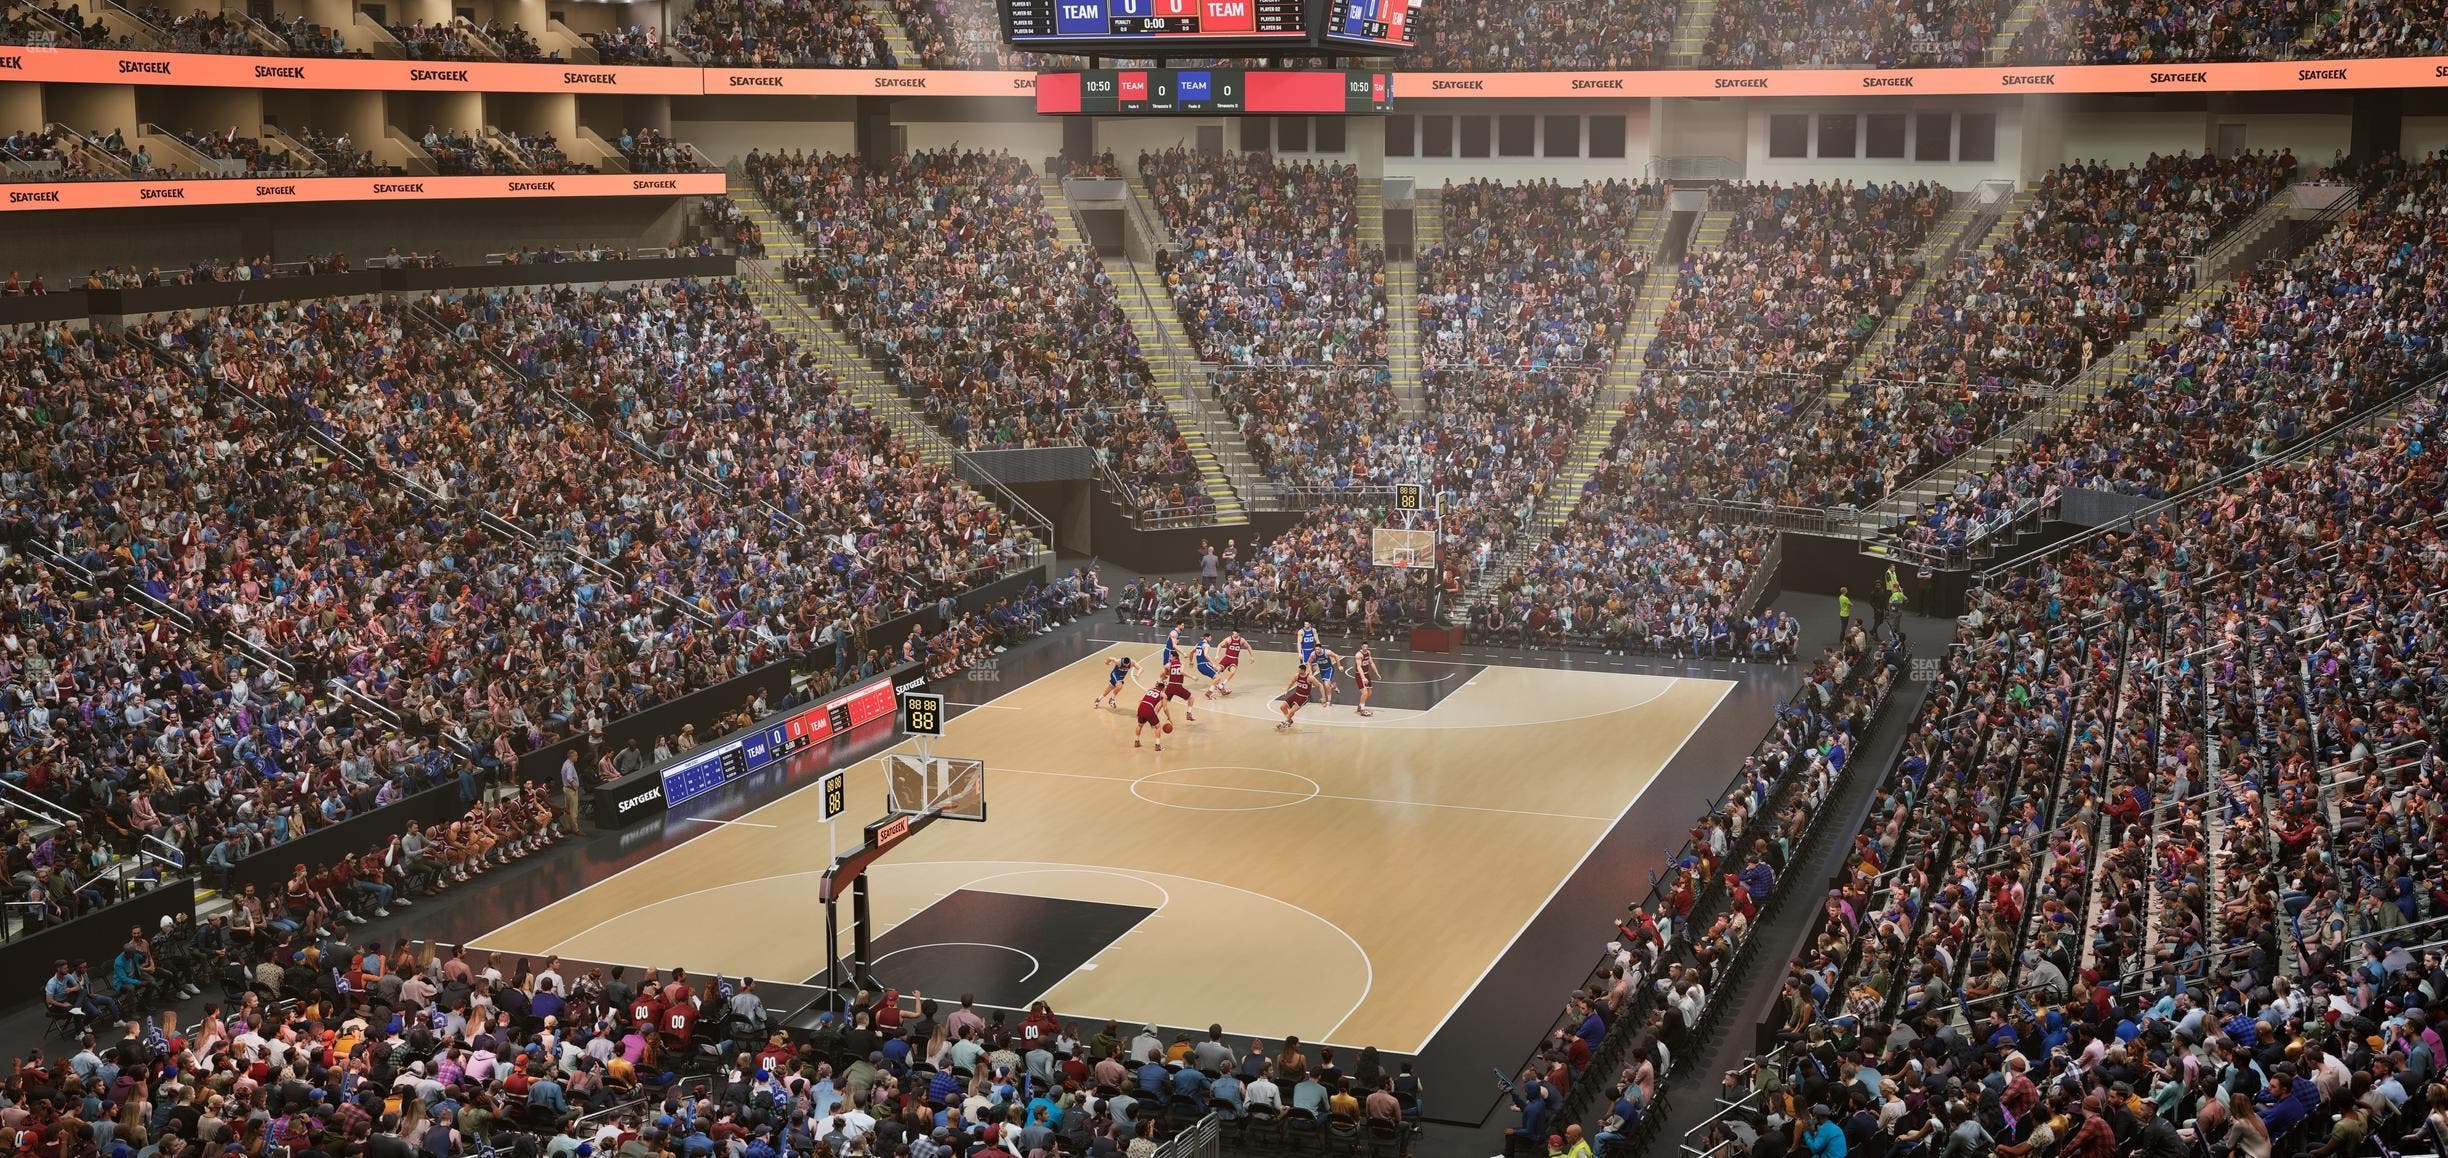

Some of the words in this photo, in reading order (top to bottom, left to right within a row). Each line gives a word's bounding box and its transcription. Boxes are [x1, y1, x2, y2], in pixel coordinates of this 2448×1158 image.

[1063, 5, 1098, 20] TEAM
[1208, 2, 1244, 17] TEAM
[1144, 18, 1165, 29] 0:00
[118, 59, 172, 75] SEATGEEK
[254, 65, 305, 79] SEATGEEK
[410, 69, 469, 82] SEATGEEK
[563, 72, 617, 85] SEATGEEK
[2001, 74, 2055, 86] SEATGEEK
[2149, 71, 2207, 84] SEATGEEK
[2298, 68, 2348, 81] SEATGEEK
[729, 76, 784, 87] SEATGEEK
[874, 77, 926, 88] SEATGEEK
[1086, 81, 1110, 92] 10:50
[1122, 82, 1144, 90] TEAM
[1181, 82, 1207, 90] TEAM
[1350, 82, 1369, 92] 10:50
[1432, 80, 1484, 90] SEATGEEK
[1571, 79, 1623, 90] SEATGEEK
[1714, 78, 1768, 89] SEATGEEK
[1862, 76, 1913, 88] SEATGEEK
[1158, 85, 1165, 96] 0
[1223, 85, 1231, 96] 0
[255, 185, 296, 197] SEATGEEK
[373, 183, 424, 194] SEATGEEK
[508, 181, 556, 192] SEATGEEK
[633, 179, 677, 190] SEATGEEK
[9, 190, 60, 204] SEATGEEK
[140, 187, 185, 200] SEATGEEK
[1401, 495, 1415, 508] 88
[895, 676, 926, 696] SEATGEEK
[909, 698, 922, 710] 88
[923, 700, 937, 711] 88
[810, 718, 827, 732] TEAM
[912, 711, 934, 730] 88
[793, 722, 800, 736] 0
[773, 730, 781, 744] 0
[747, 744, 766, 759] TEAM
[618, 786, 662, 813] SEATGEEK
[829, 791, 841, 814] 88
[880, 820, 905, 842] SEATGEEK
[635, 1005, 648, 1020] 00
[671, 1015, 685, 1029] 00
[1025, 1025, 1039, 1040] 00
[762, 1056, 776, 1071] 00
